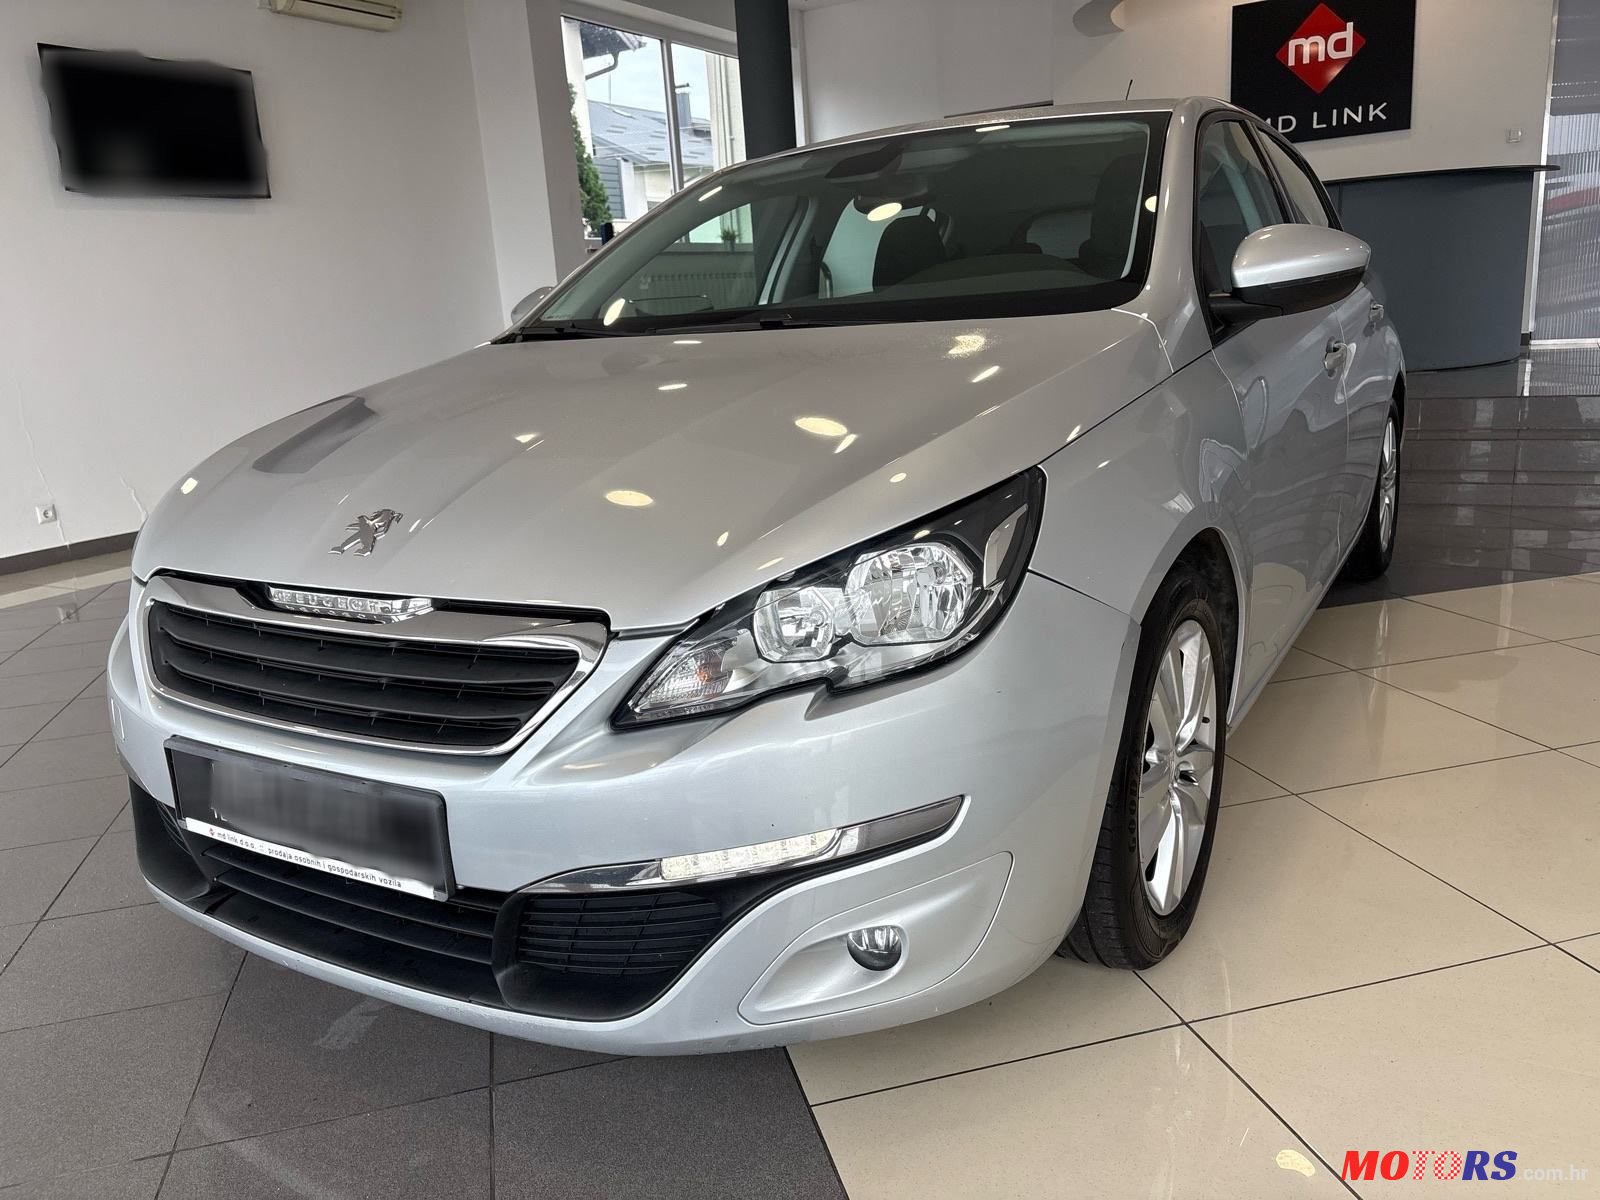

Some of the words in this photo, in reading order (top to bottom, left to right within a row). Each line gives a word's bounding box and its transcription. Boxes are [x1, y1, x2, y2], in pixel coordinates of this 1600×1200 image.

[1287, 21, 1354, 67] md
[1264, 115, 1297, 134] D
[1312, 102, 1388, 129] LINK
[267, 848, 293, 861] prodaja
[294, 855, 321, 868] osobnih
[327, 864, 377, 881] gospodarskih
[378, 877, 402, 888] vozila
